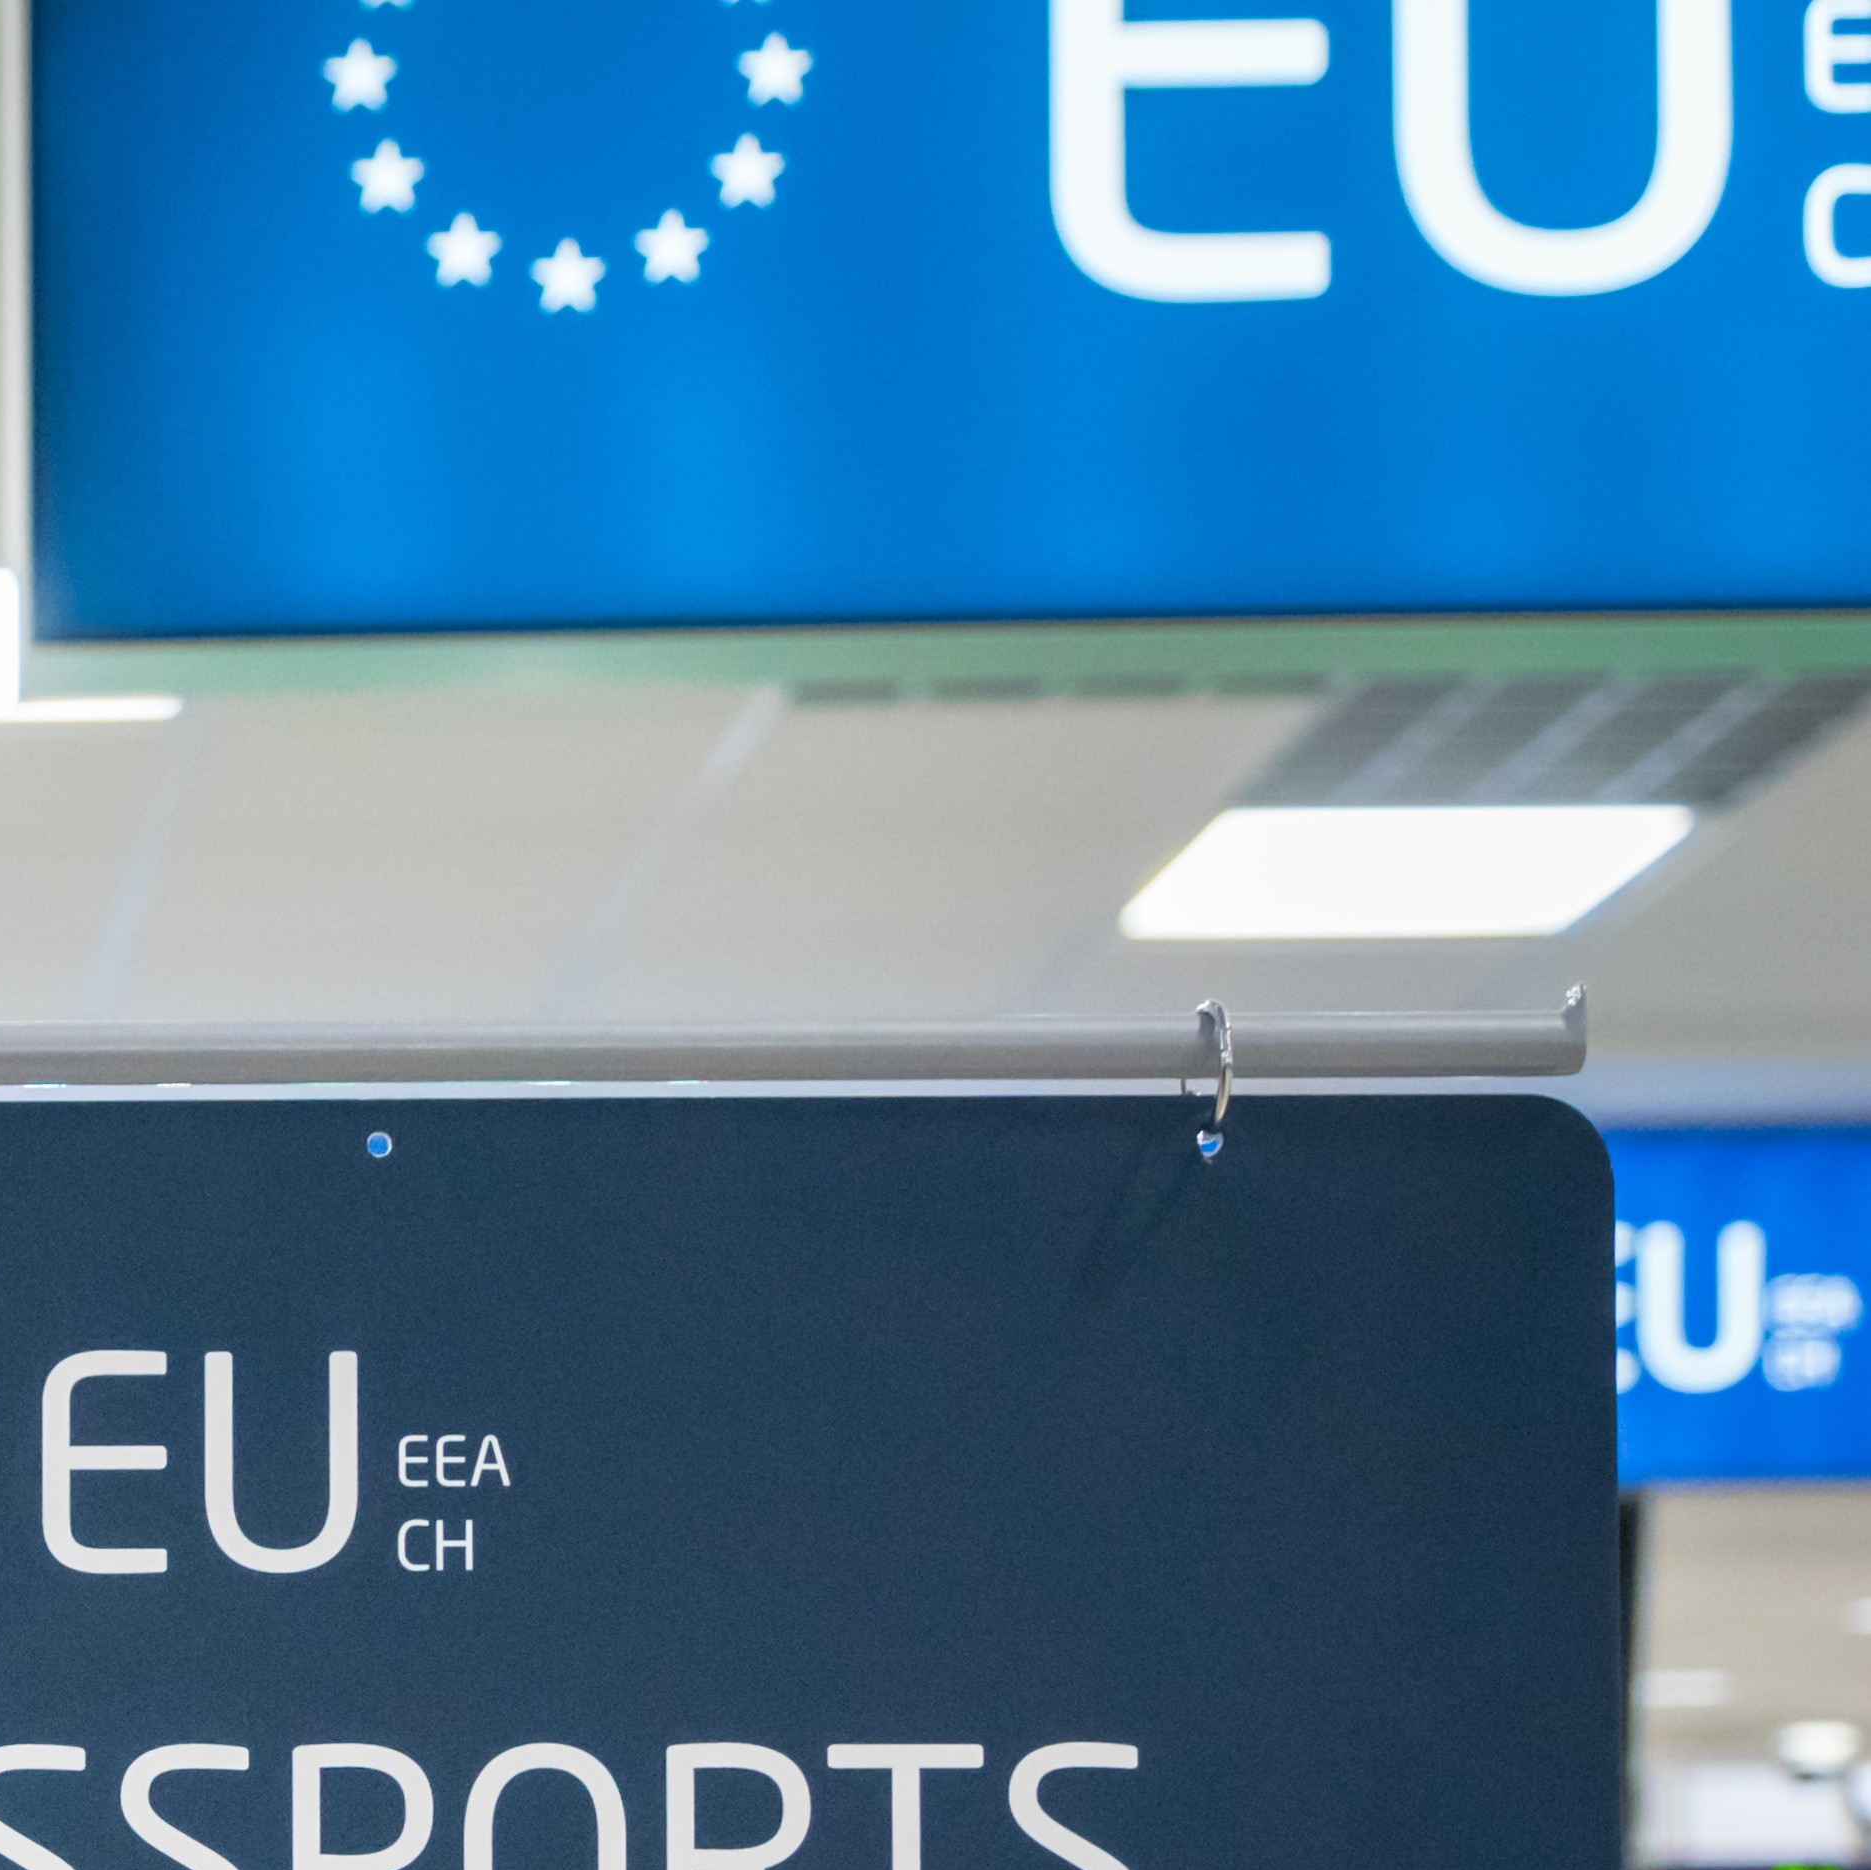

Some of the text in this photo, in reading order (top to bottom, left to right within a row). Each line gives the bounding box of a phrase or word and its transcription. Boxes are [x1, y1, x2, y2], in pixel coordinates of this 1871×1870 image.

[1048, 0, 1734, 304] EU
[1615, 1219, 1766, 1395] U
[40, 1348, 360, 1576] EU
[396, 1517, 475, 1573] CH
[397, 1433, 512, 1489] EEA
